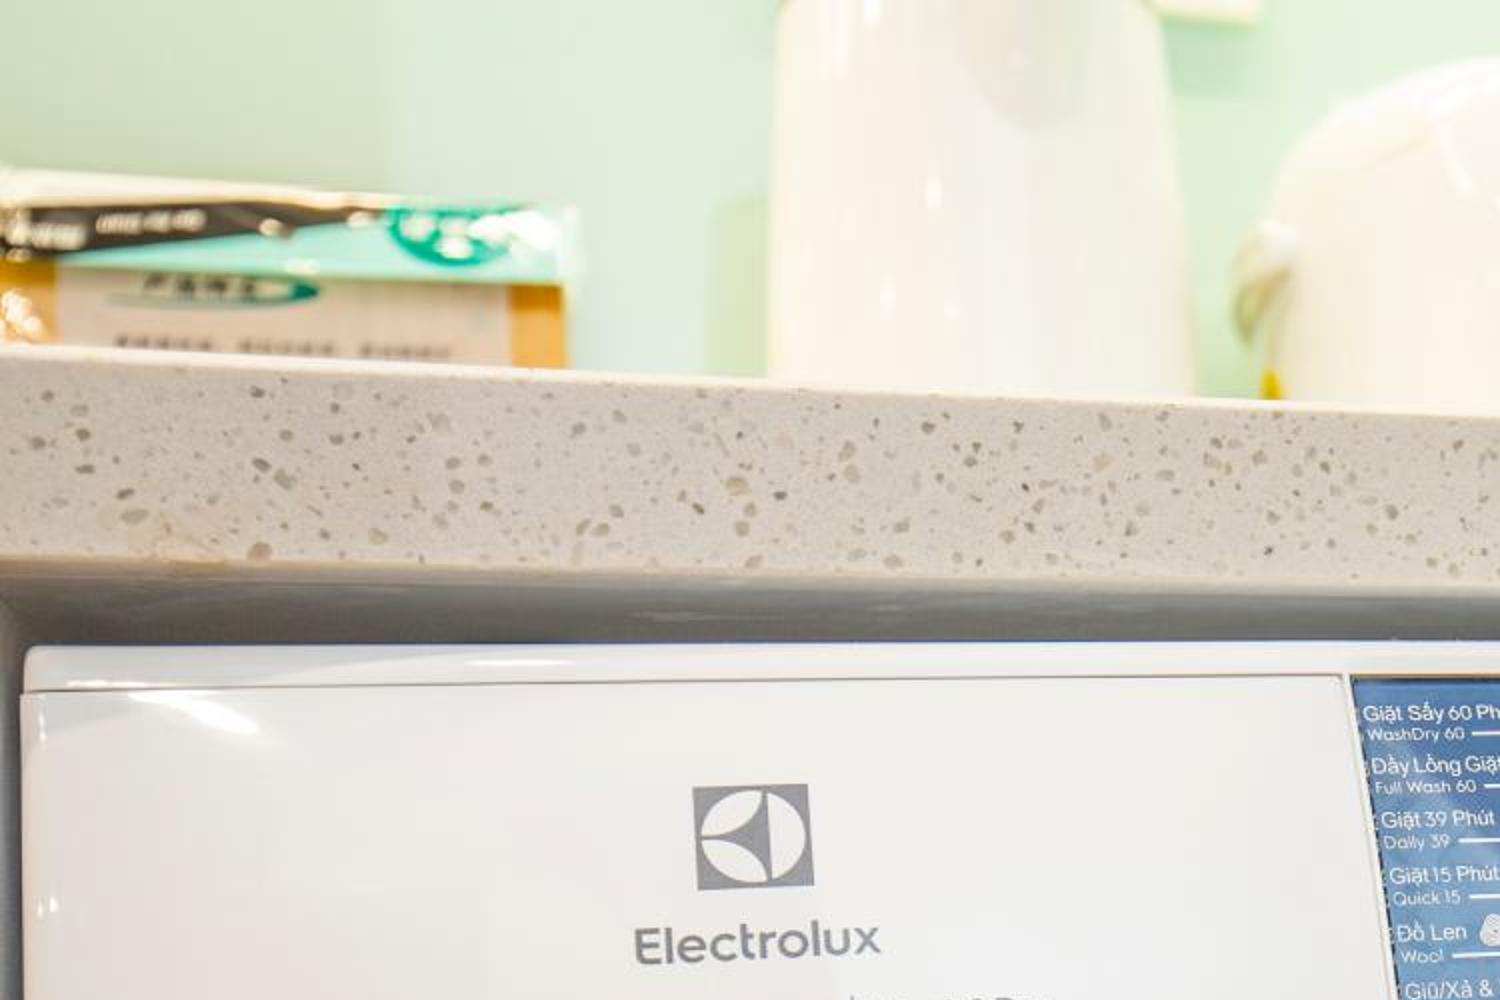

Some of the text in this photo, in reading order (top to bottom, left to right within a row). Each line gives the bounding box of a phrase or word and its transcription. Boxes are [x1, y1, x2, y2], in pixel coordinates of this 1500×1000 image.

[1362, 704, 1403, 724] Giặt
[1448, 706, 1472, 720] 60
[1366, 727, 1465, 744] WashDry 60
[1375, 780, 1477, 795] Full Wash 60
[1381, 809, 1496, 831] Giặt 39 Phút
[1384, 834, 1451, 852] Daily 39
[1390, 864, 1500, 887] Giặt 15 Phút
[1393, 891, 1462, 906] Quick 15
[1431, 925, 1468, 941] Len
[633, 920, 882, 965] Electrolux
[1401, 949, 1444, 963] Wool
[1478, 979, 1495, 998] &
